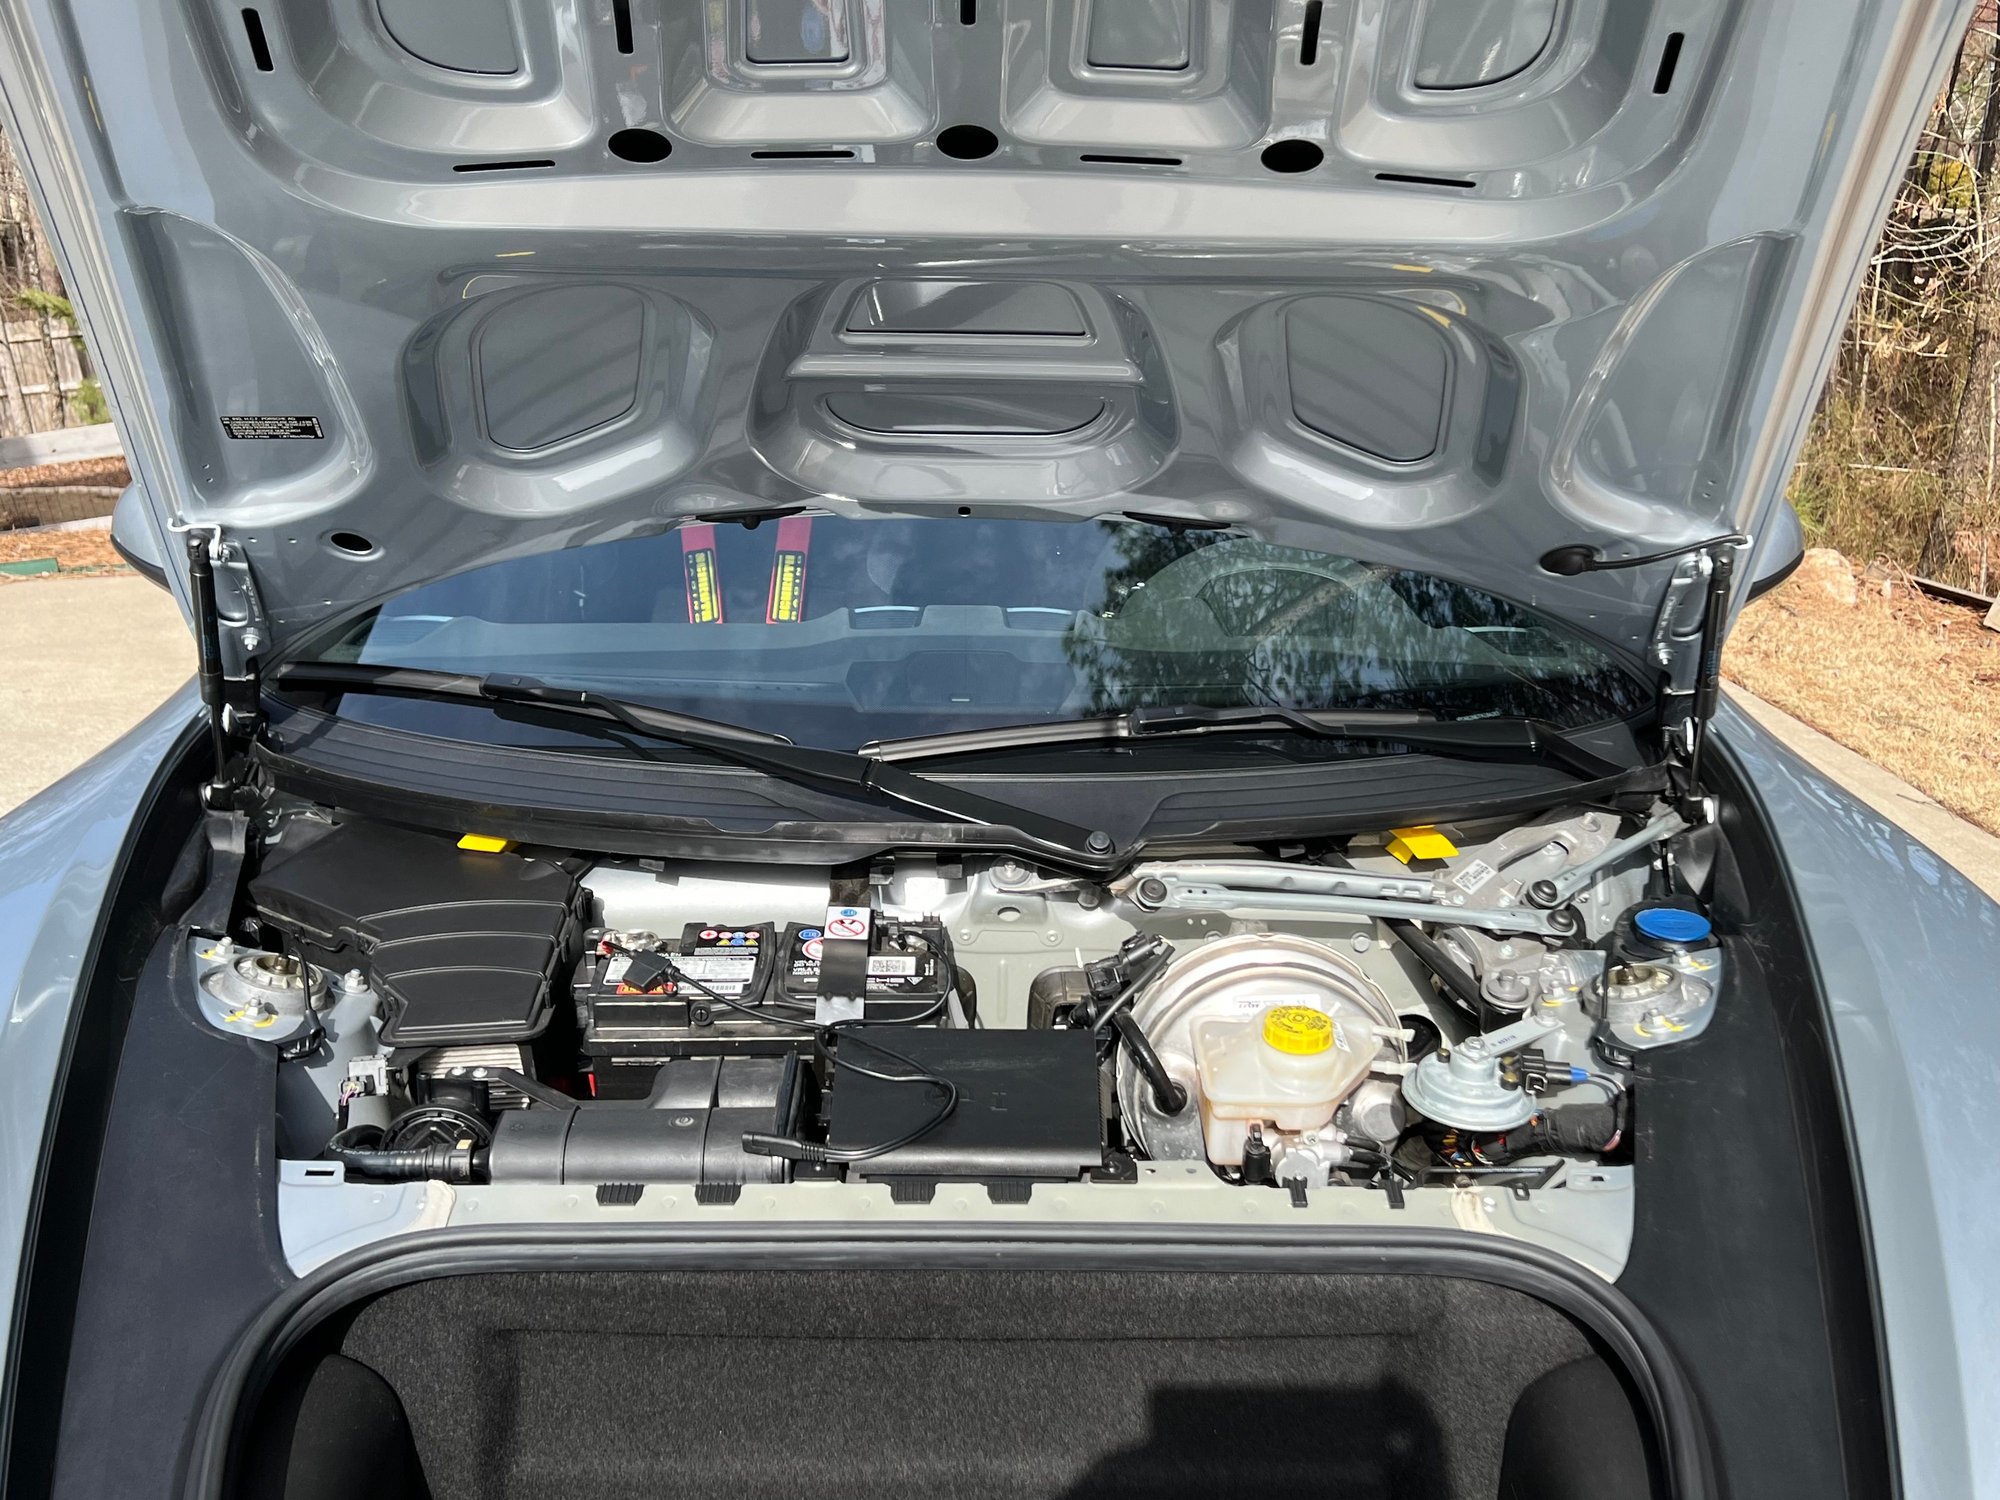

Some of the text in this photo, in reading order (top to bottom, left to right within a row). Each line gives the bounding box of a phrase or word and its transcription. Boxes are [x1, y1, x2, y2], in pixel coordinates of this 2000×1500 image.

[688, 554, 700, 624] RACING
[778, 554, 795, 621] SCHROTH
[790, 555, 802, 621] RACING
